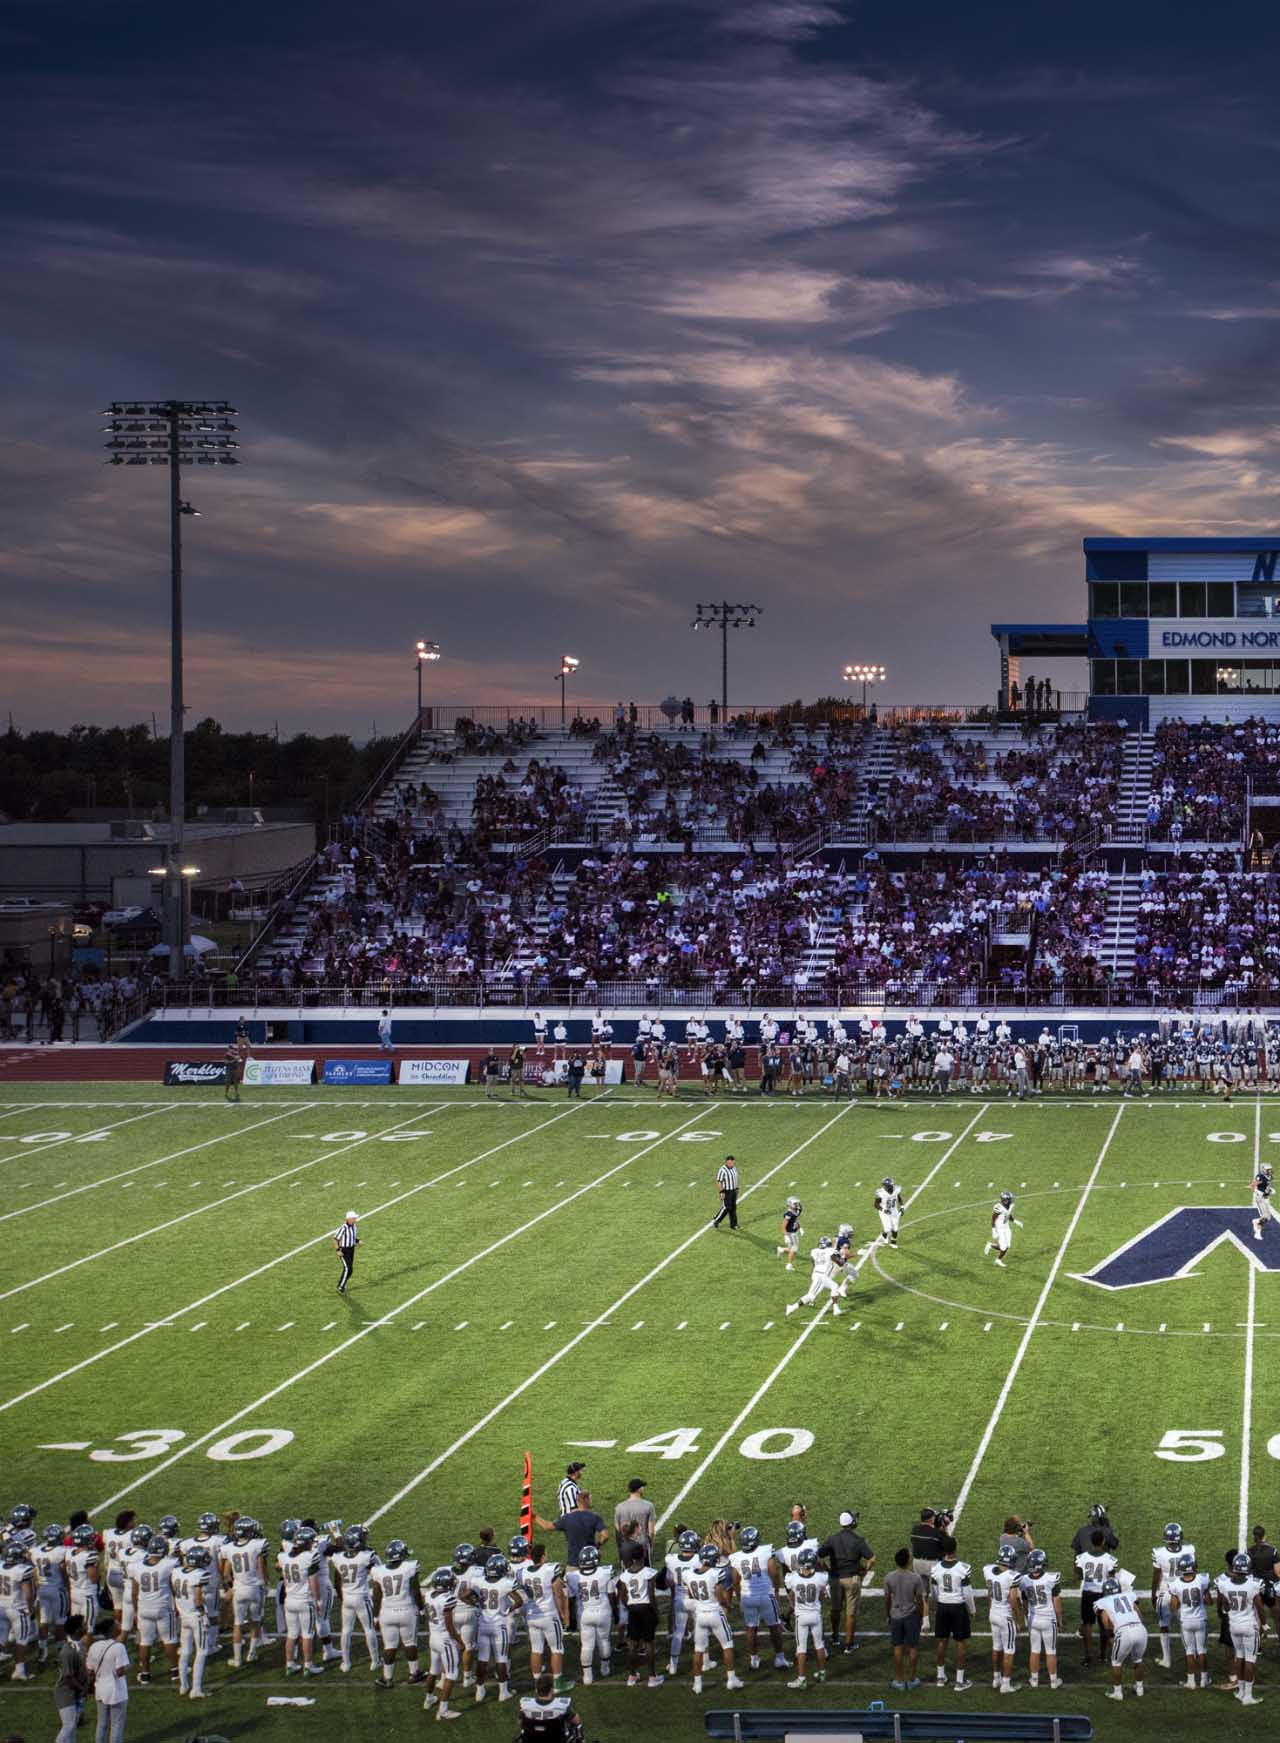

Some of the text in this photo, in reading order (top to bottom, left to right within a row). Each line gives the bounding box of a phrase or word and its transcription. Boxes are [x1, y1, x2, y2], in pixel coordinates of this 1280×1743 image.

[1252, 552, 1279, 581] N
[1162, 631, 1236, 647] EDMOND
[411, 1062, 460, 1072] MIDCON
[140, 1571, 160, 1593] 91
[340, 1563, 358, 1584] 27
[1085, 1561, 1104, 1583] 24
[383, 1574, 404, 1597] 97
[579, 1579, 600, 1602] 54
[629, 1578, 641, 1599] 2
[943, 1573, 953, 1593] 9
[1112, 1595, 1132, 1614] 41
[1229, 1590, 1248, 1611] 57
